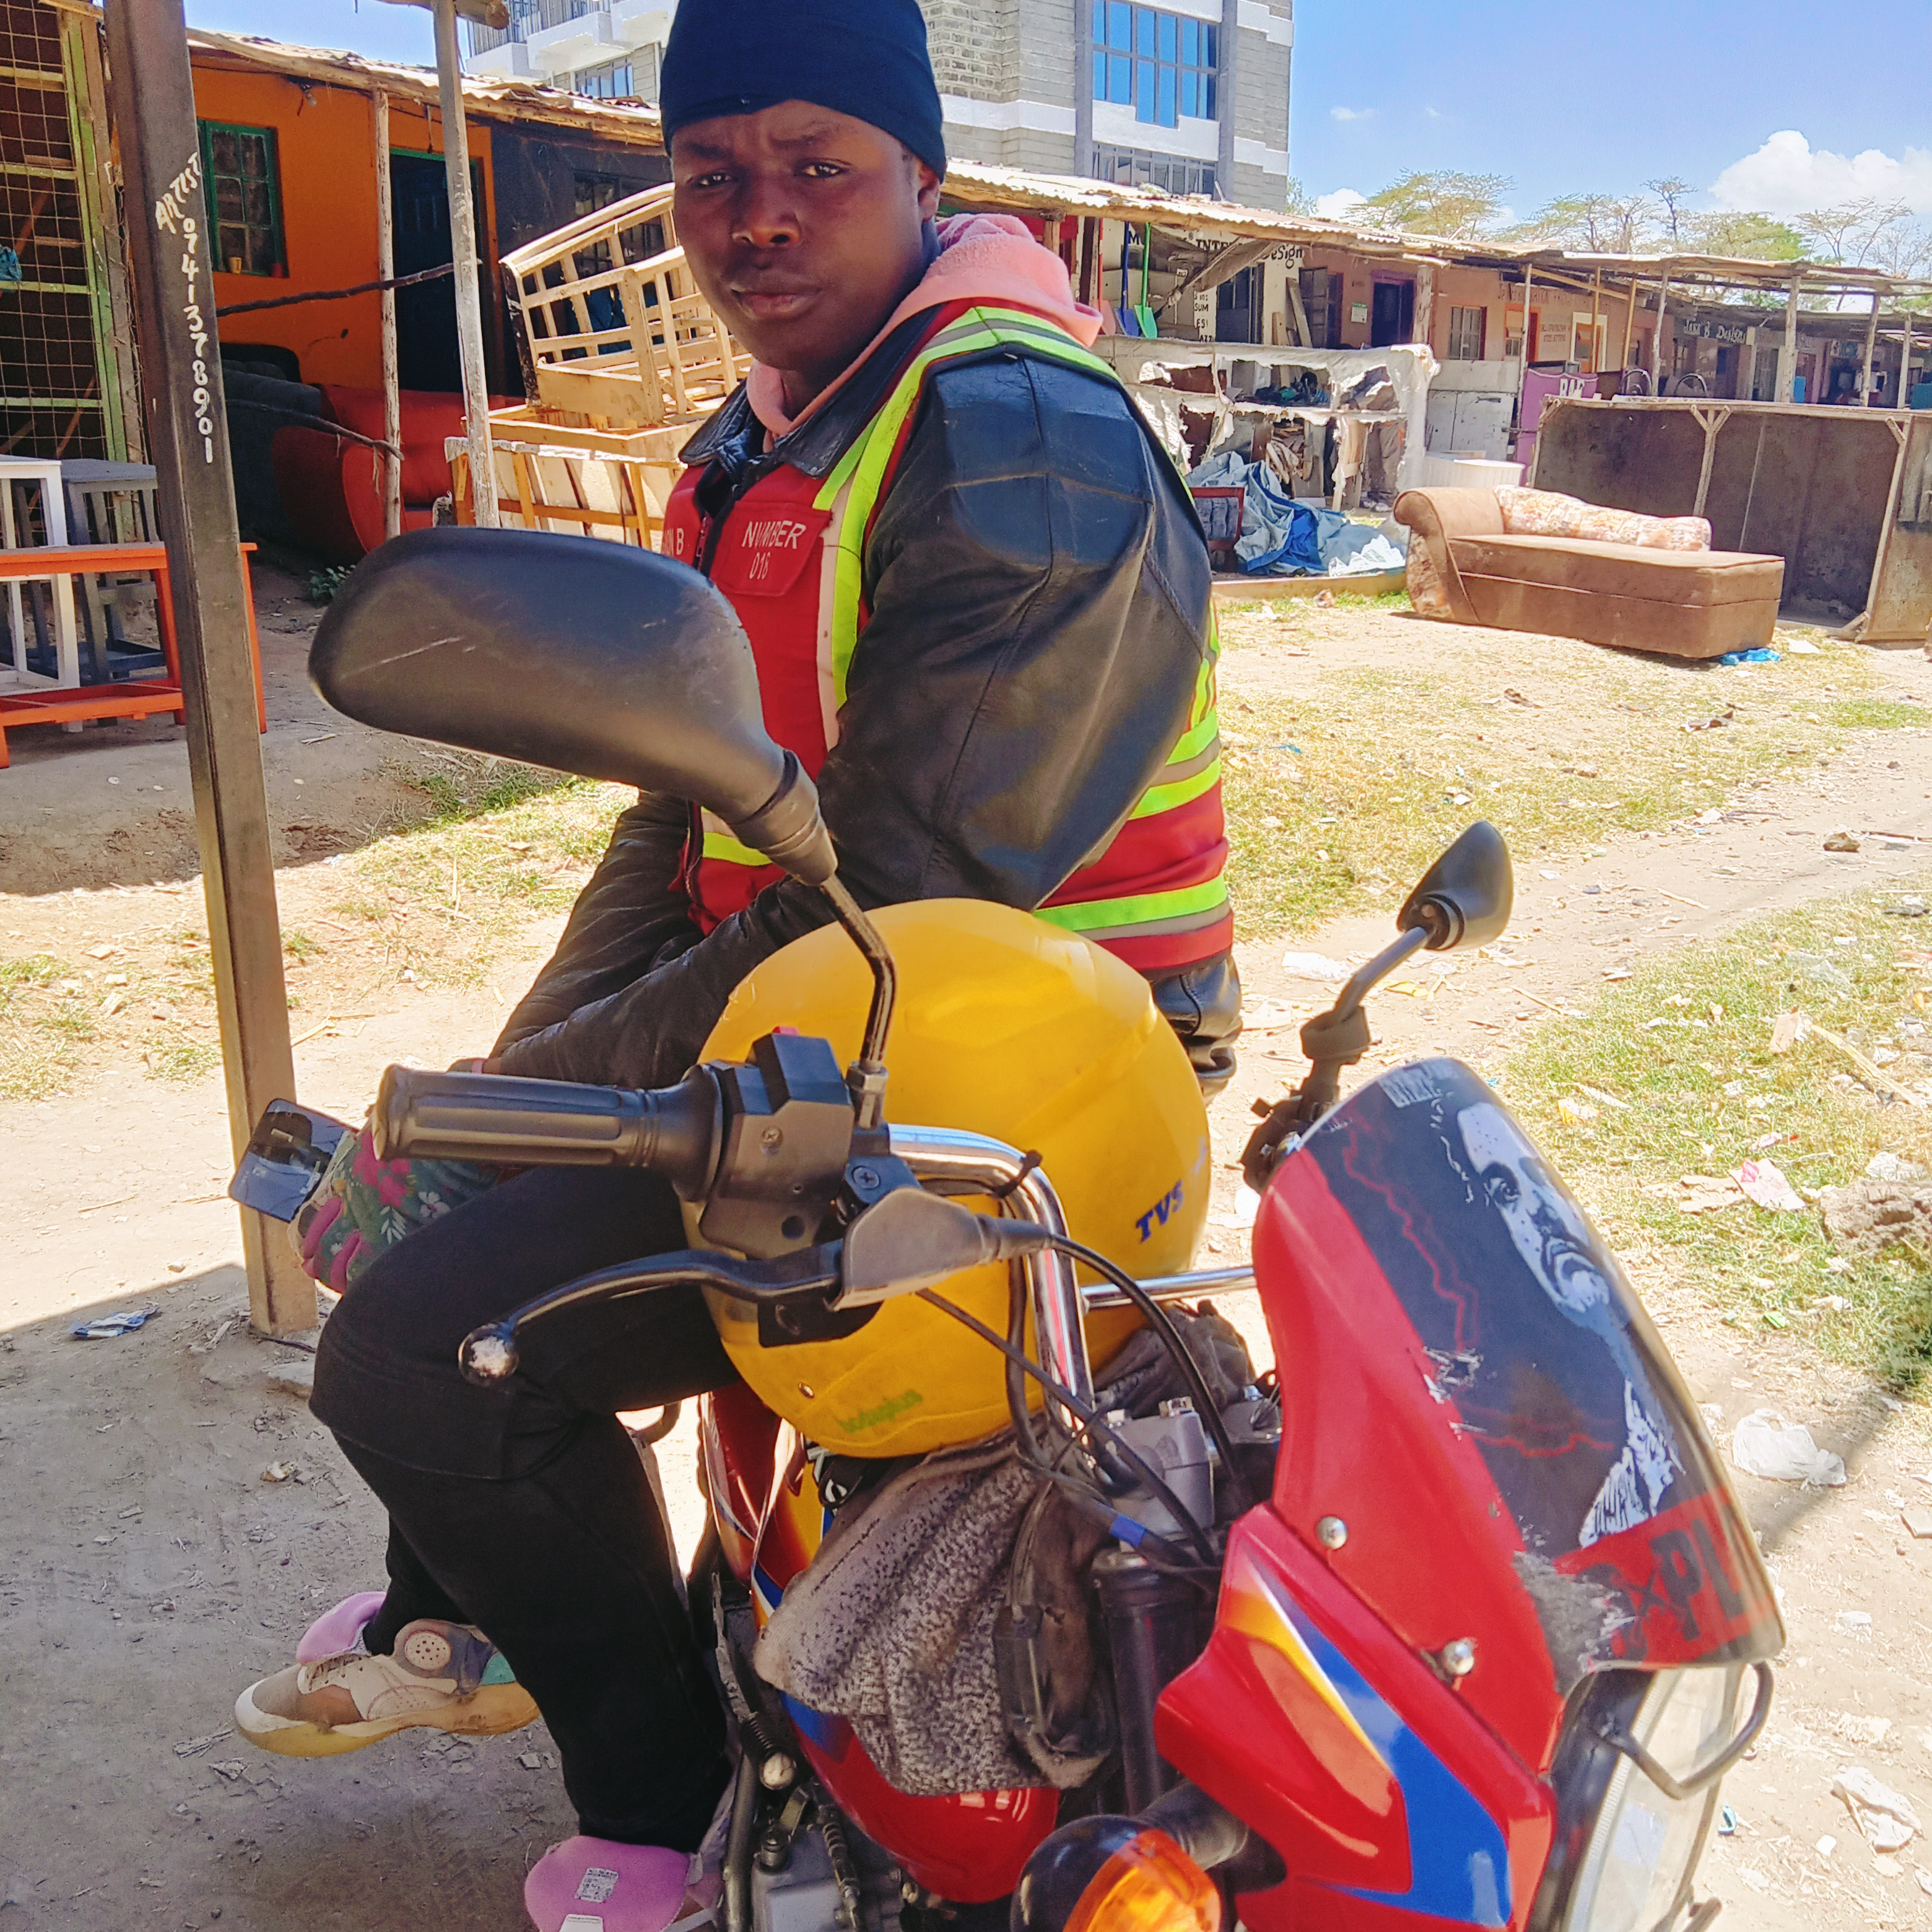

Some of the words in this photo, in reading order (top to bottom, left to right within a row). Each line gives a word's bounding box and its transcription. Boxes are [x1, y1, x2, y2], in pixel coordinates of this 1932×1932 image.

[155, 152, 201, 234] ARTIST
[1194, 303, 1209, 312] SUM
[676, 528, 684, 555] B
[742, 520, 806, 549] NUMBER
[749, 552, 771, 580] 018
[1136, 1179, 1185, 1244] TVS
